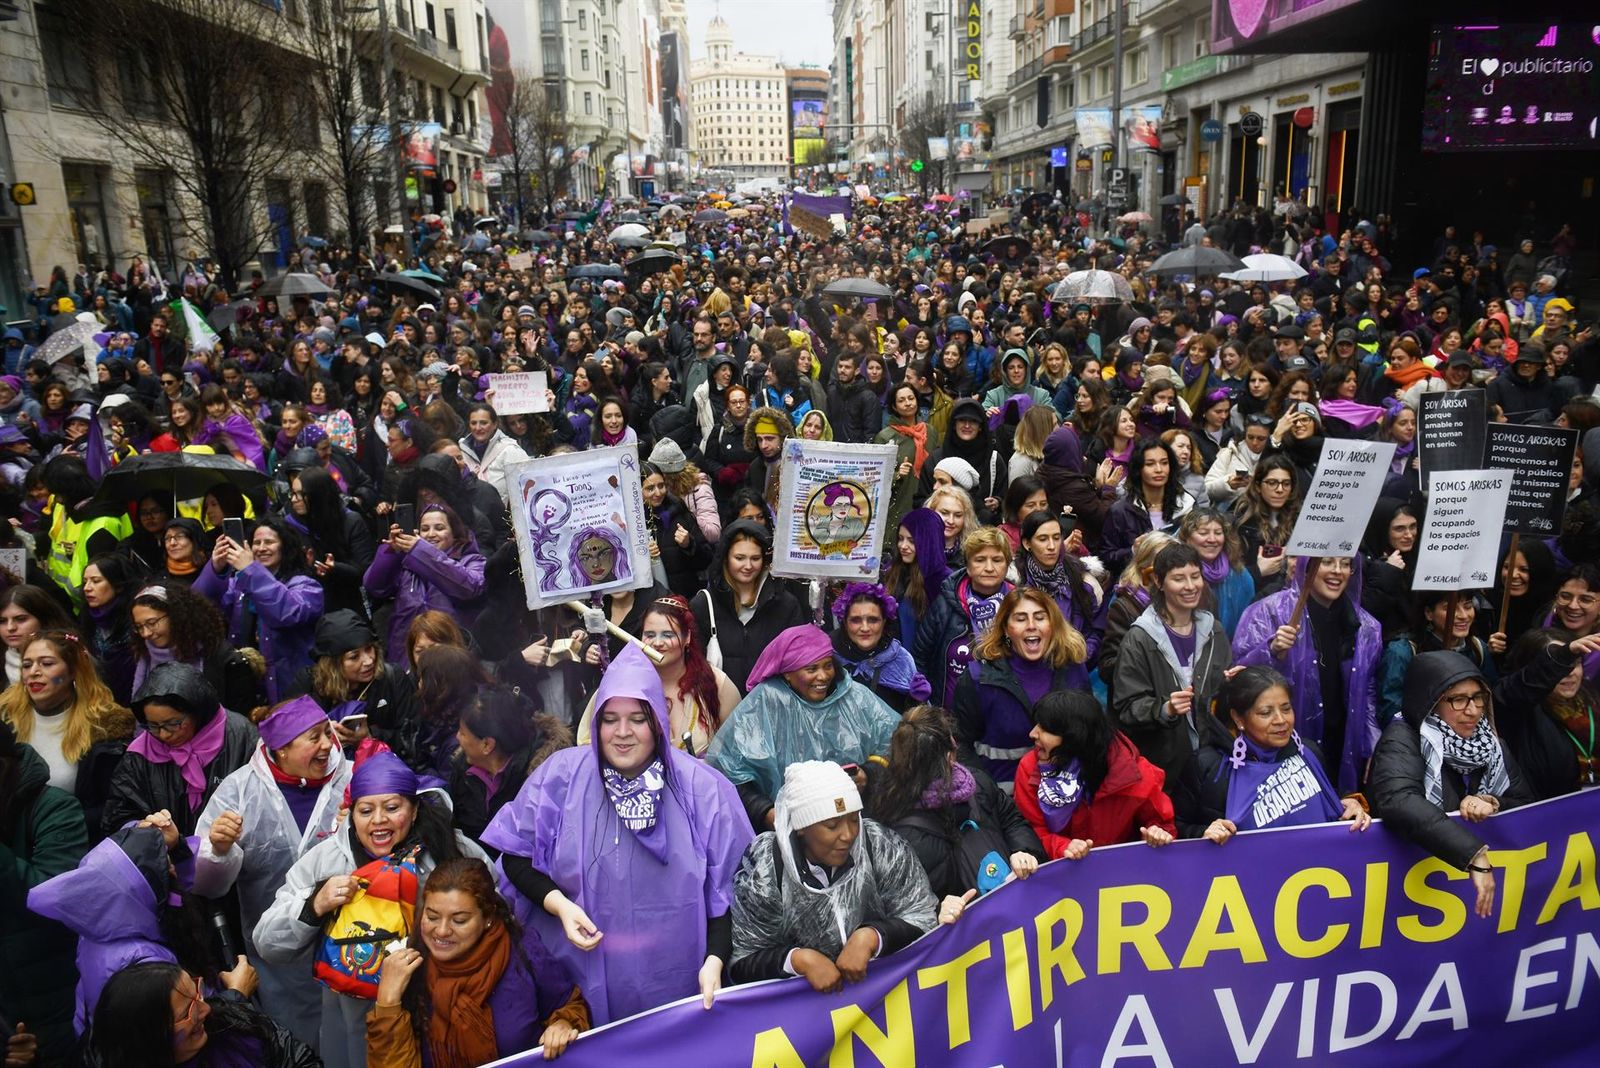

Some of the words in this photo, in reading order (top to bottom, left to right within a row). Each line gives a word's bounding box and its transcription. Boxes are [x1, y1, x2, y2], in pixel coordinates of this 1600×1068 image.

[1462, 58, 1478, 74] El
[1501, 57, 1593, 77] publicitario
[1482, 79, 1494, 95] d
[1112, 169, 1124, 185] P
[1424, 400, 1439, 410] SOY
[1440, 398, 1468, 409] ARISKA
[1424, 412, 1452, 420] porque
[1424, 421, 1453, 429] amable
[1436, 440, 1457, 448] serio.
[1491, 432, 1525, 444] SOMOS
[1526, 435, 1567, 447] ARISKAS
[1492, 444, 1527, 454] porque
[1327, 449, 1346, 462] SOY
[1346, 451, 1377, 463] ARISKA
[1491, 455, 1547, 466] merecemos
[1323, 468, 1353, 478] porque
[1527, 468, 1564, 477] público
[1319, 480, 1340, 489] pago
[1435, 481, 1466, 492] SOMOS
[1468, 479, 1502, 490] ARISKAS
[1522, 479, 1560, 488] mismas
[1314, 491, 1344, 500] terapia
[1532, 491, 1551, 499] que
[1435, 496, 1468, 505] porque
[1507, 499, 1545, 508] ombres.
[1328, 503, 1337, 511] tú
[1433, 508, 1463, 516] siguen
[1306, 514, 1345, 523] necesitas.
[1431, 519, 1475, 528] ocupando
[1429, 531, 1442, 539] los
[1444, 530, 1481, 540] espacios
[1427, 543, 1439, 551] de
[1441, 543, 1469, 552] poder.
[615, 803, 654, 818] CALLES!
[1213, 961, 1469, 1065] VIDA
